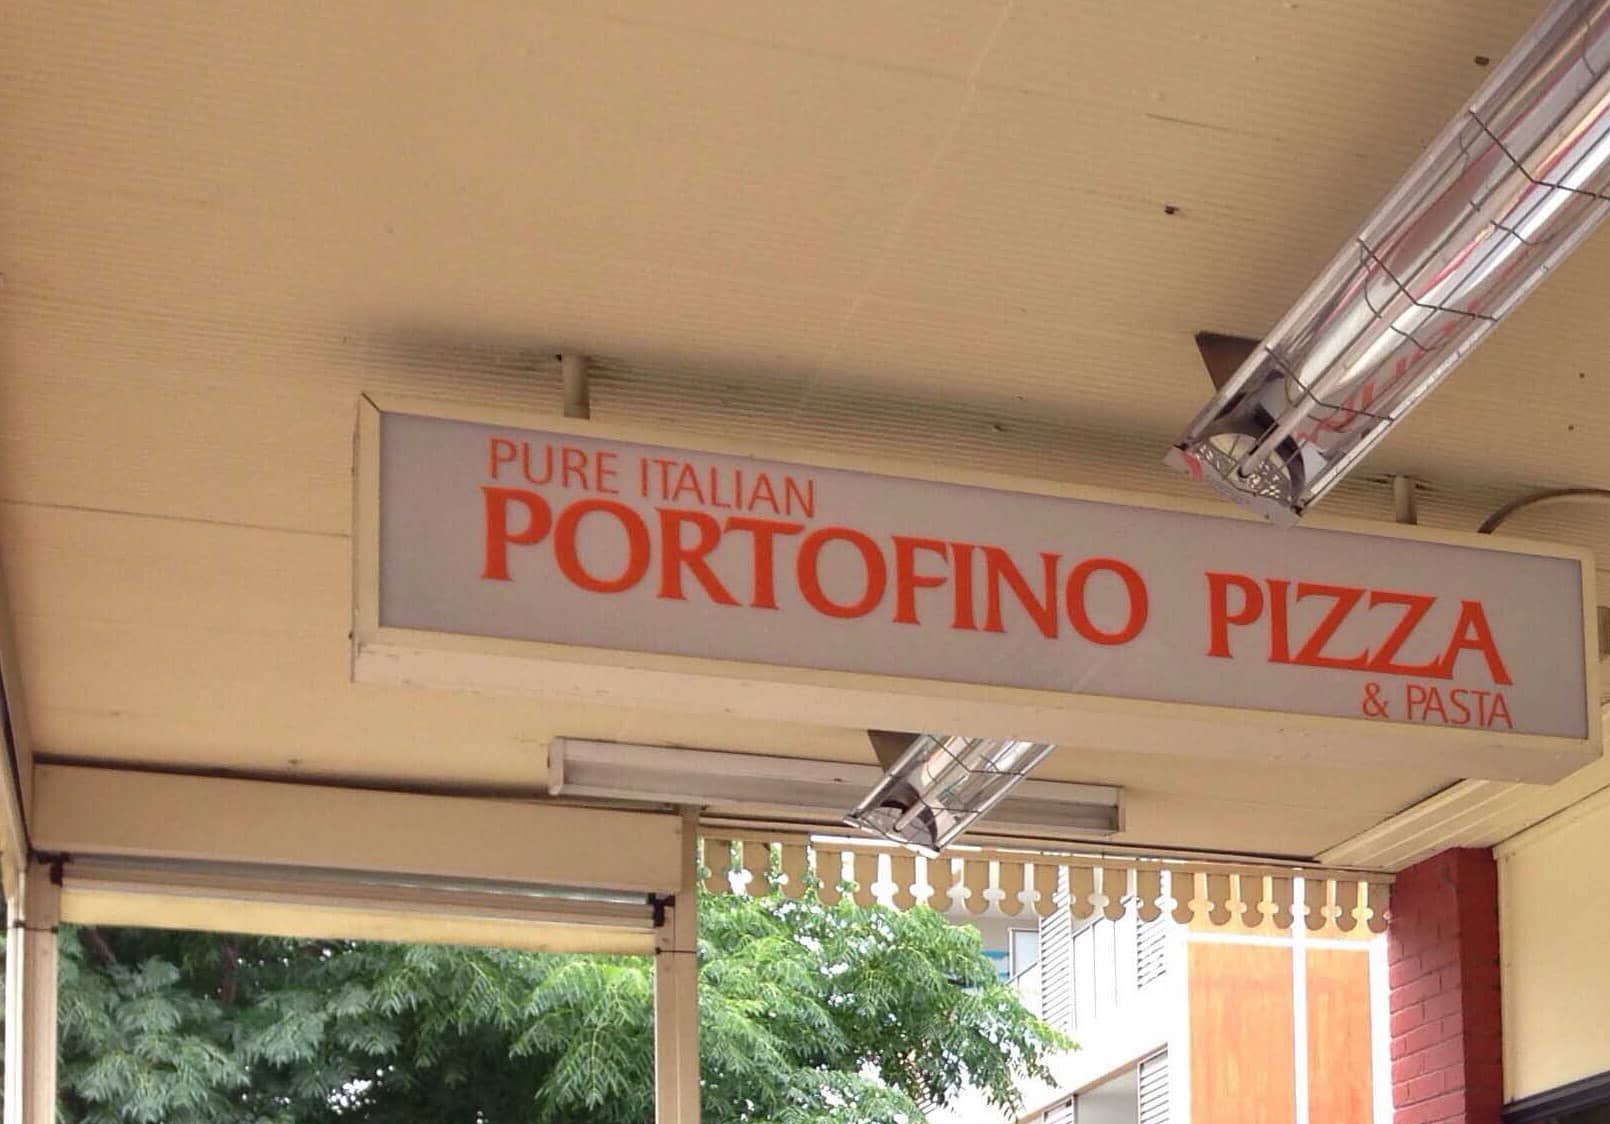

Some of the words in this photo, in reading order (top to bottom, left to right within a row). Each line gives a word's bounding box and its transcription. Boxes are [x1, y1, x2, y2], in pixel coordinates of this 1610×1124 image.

[488, 436, 619, 495] PURE
[638, 455, 816, 520] ITALIAN
[479, 485, 1150, 647] PORTOFINO
[1203, 570, 1513, 687] PIZZA
[1359, 680, 1389, 719] &
[1403, 681, 1514, 730] PASTA
